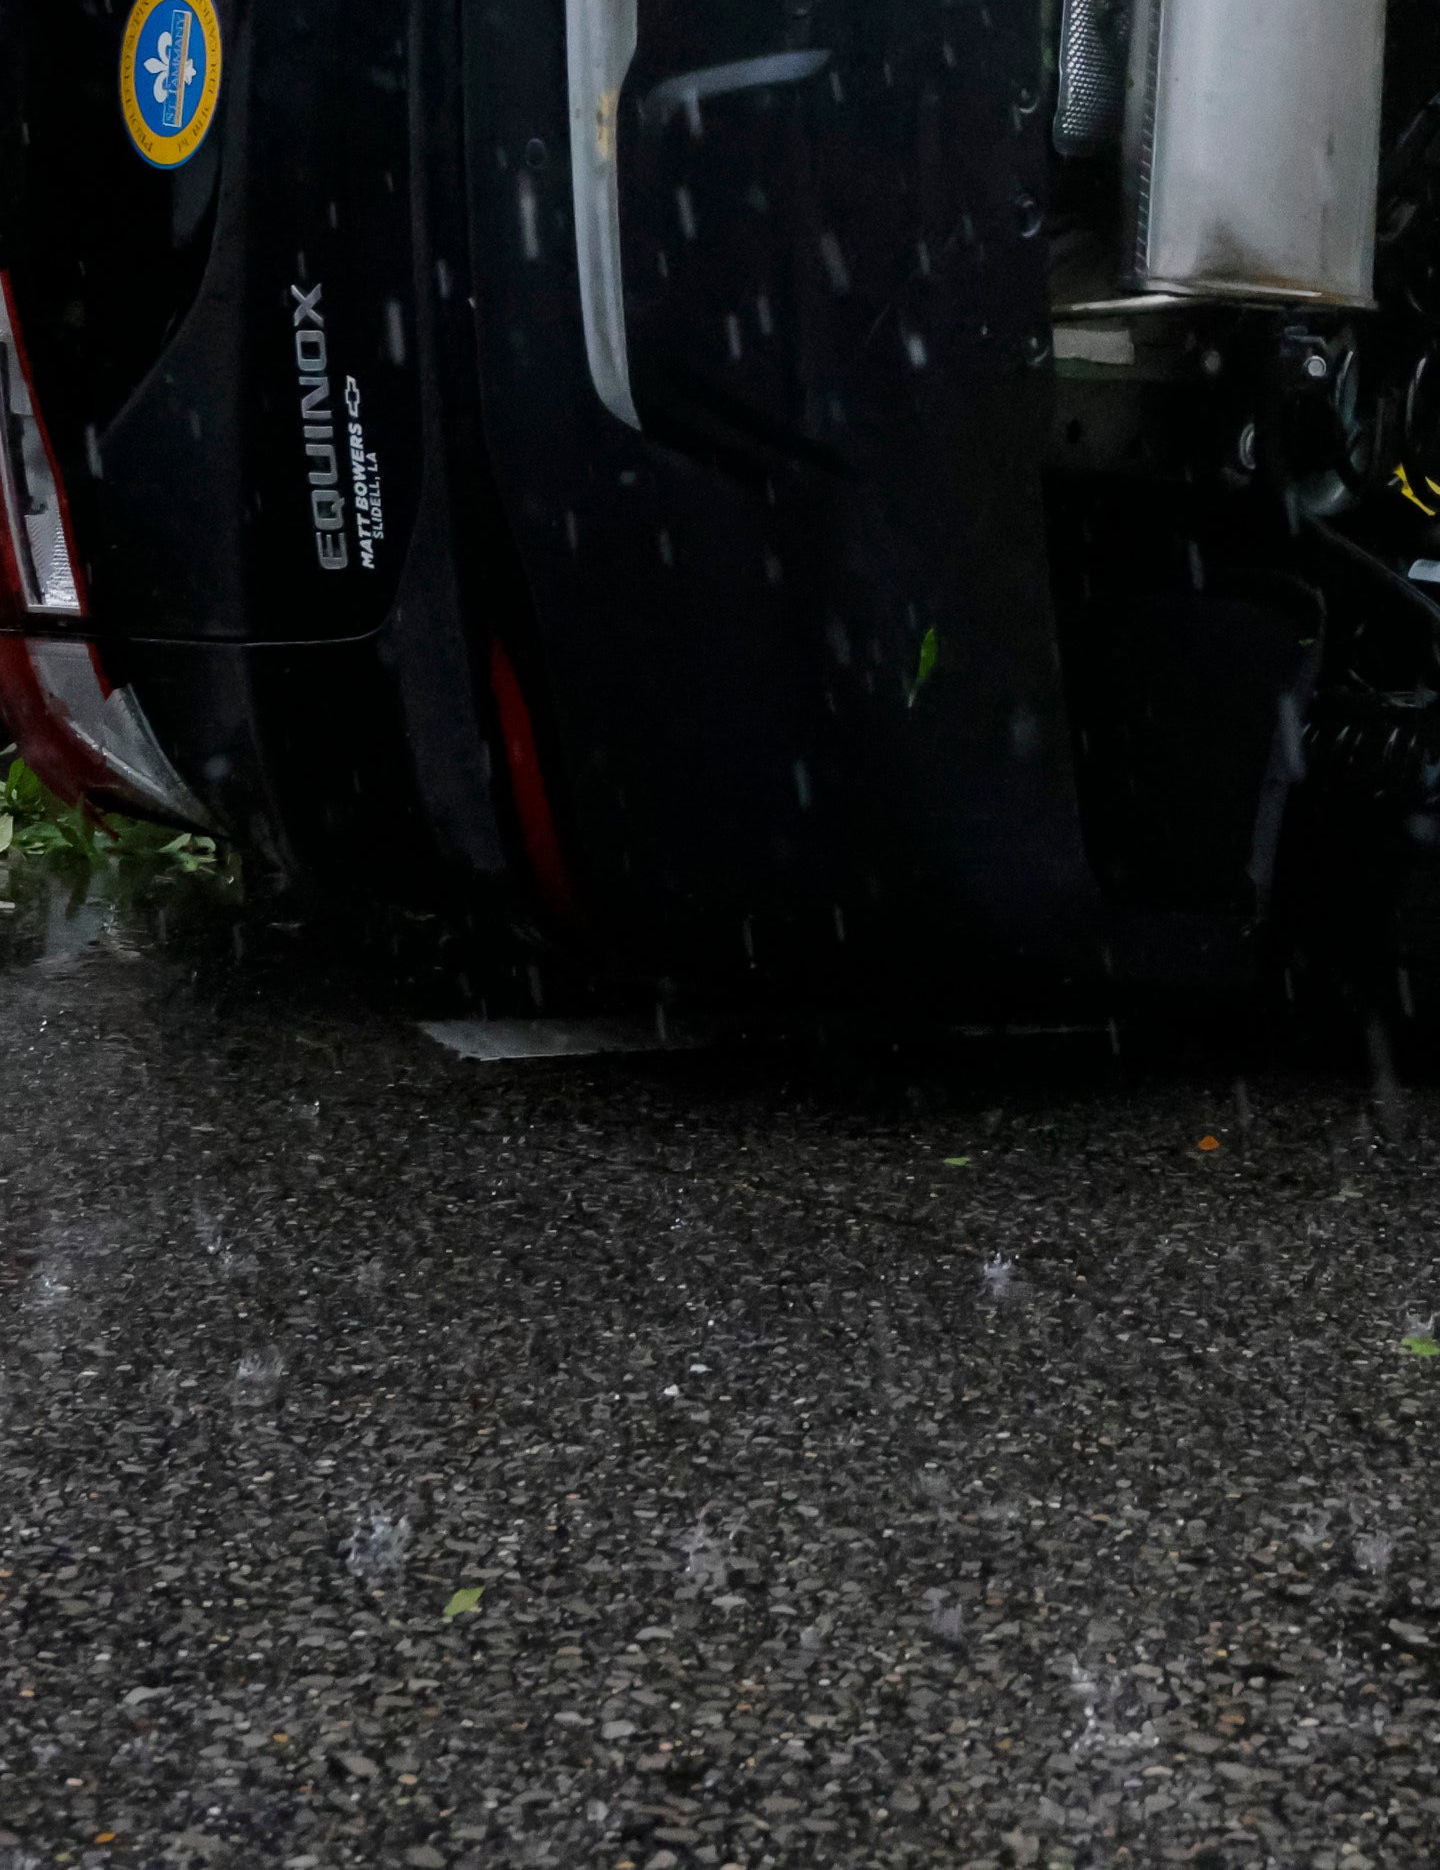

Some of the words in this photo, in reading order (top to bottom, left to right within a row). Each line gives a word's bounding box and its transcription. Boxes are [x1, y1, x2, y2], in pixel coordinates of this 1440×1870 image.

[291, 282, 347, 570] EQUINOX
[348, 421, 369, 510] BOWERS
[366, 451, 378, 472] LA
[370, 475, 384, 539] SLIDELL,
[357, 512, 375, 569] MATT
